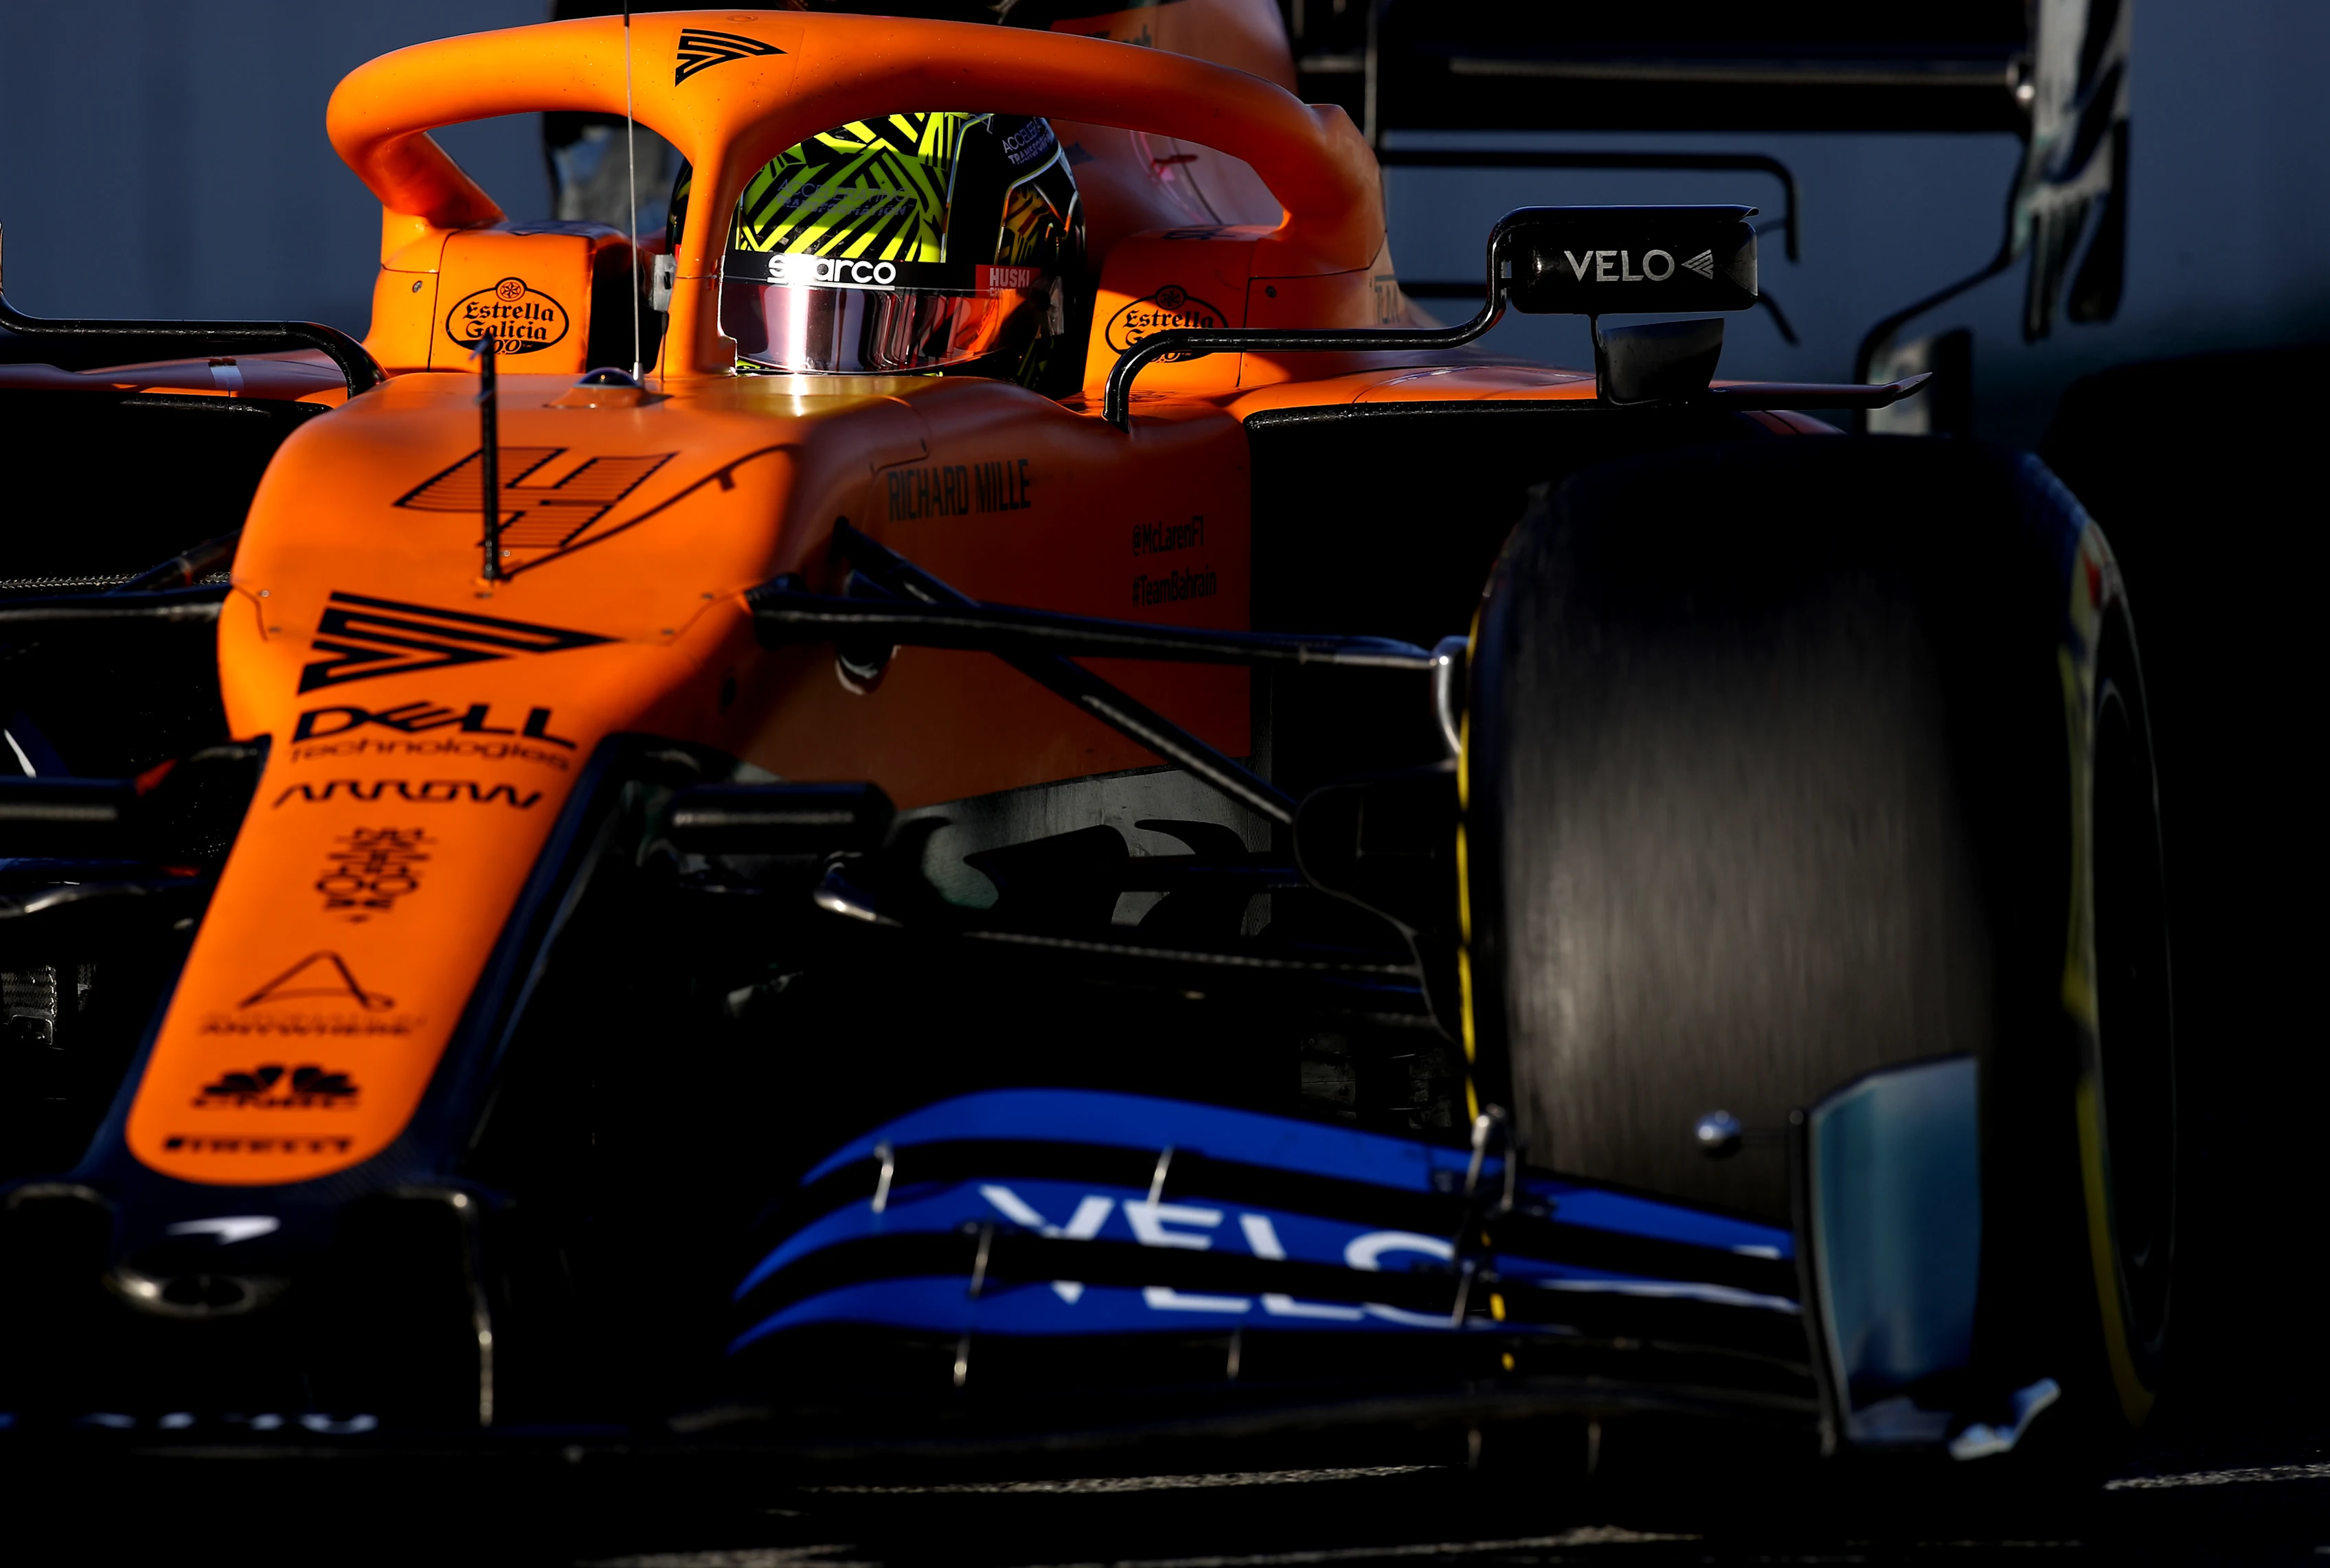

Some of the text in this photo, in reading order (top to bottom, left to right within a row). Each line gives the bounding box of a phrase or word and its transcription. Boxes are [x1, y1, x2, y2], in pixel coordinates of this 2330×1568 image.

[989, 267, 1030, 288] HUSKI
[1563, 249, 1675, 282] VELO
[463, 301, 554, 321] Estrella
[886, 458, 1031, 521] RICHARD MILLE
[1131, 514, 1204, 557] @McLarenF1
[1131, 565, 1217, 607] #TeamBahrain
[291, 701, 577, 750] DELL
